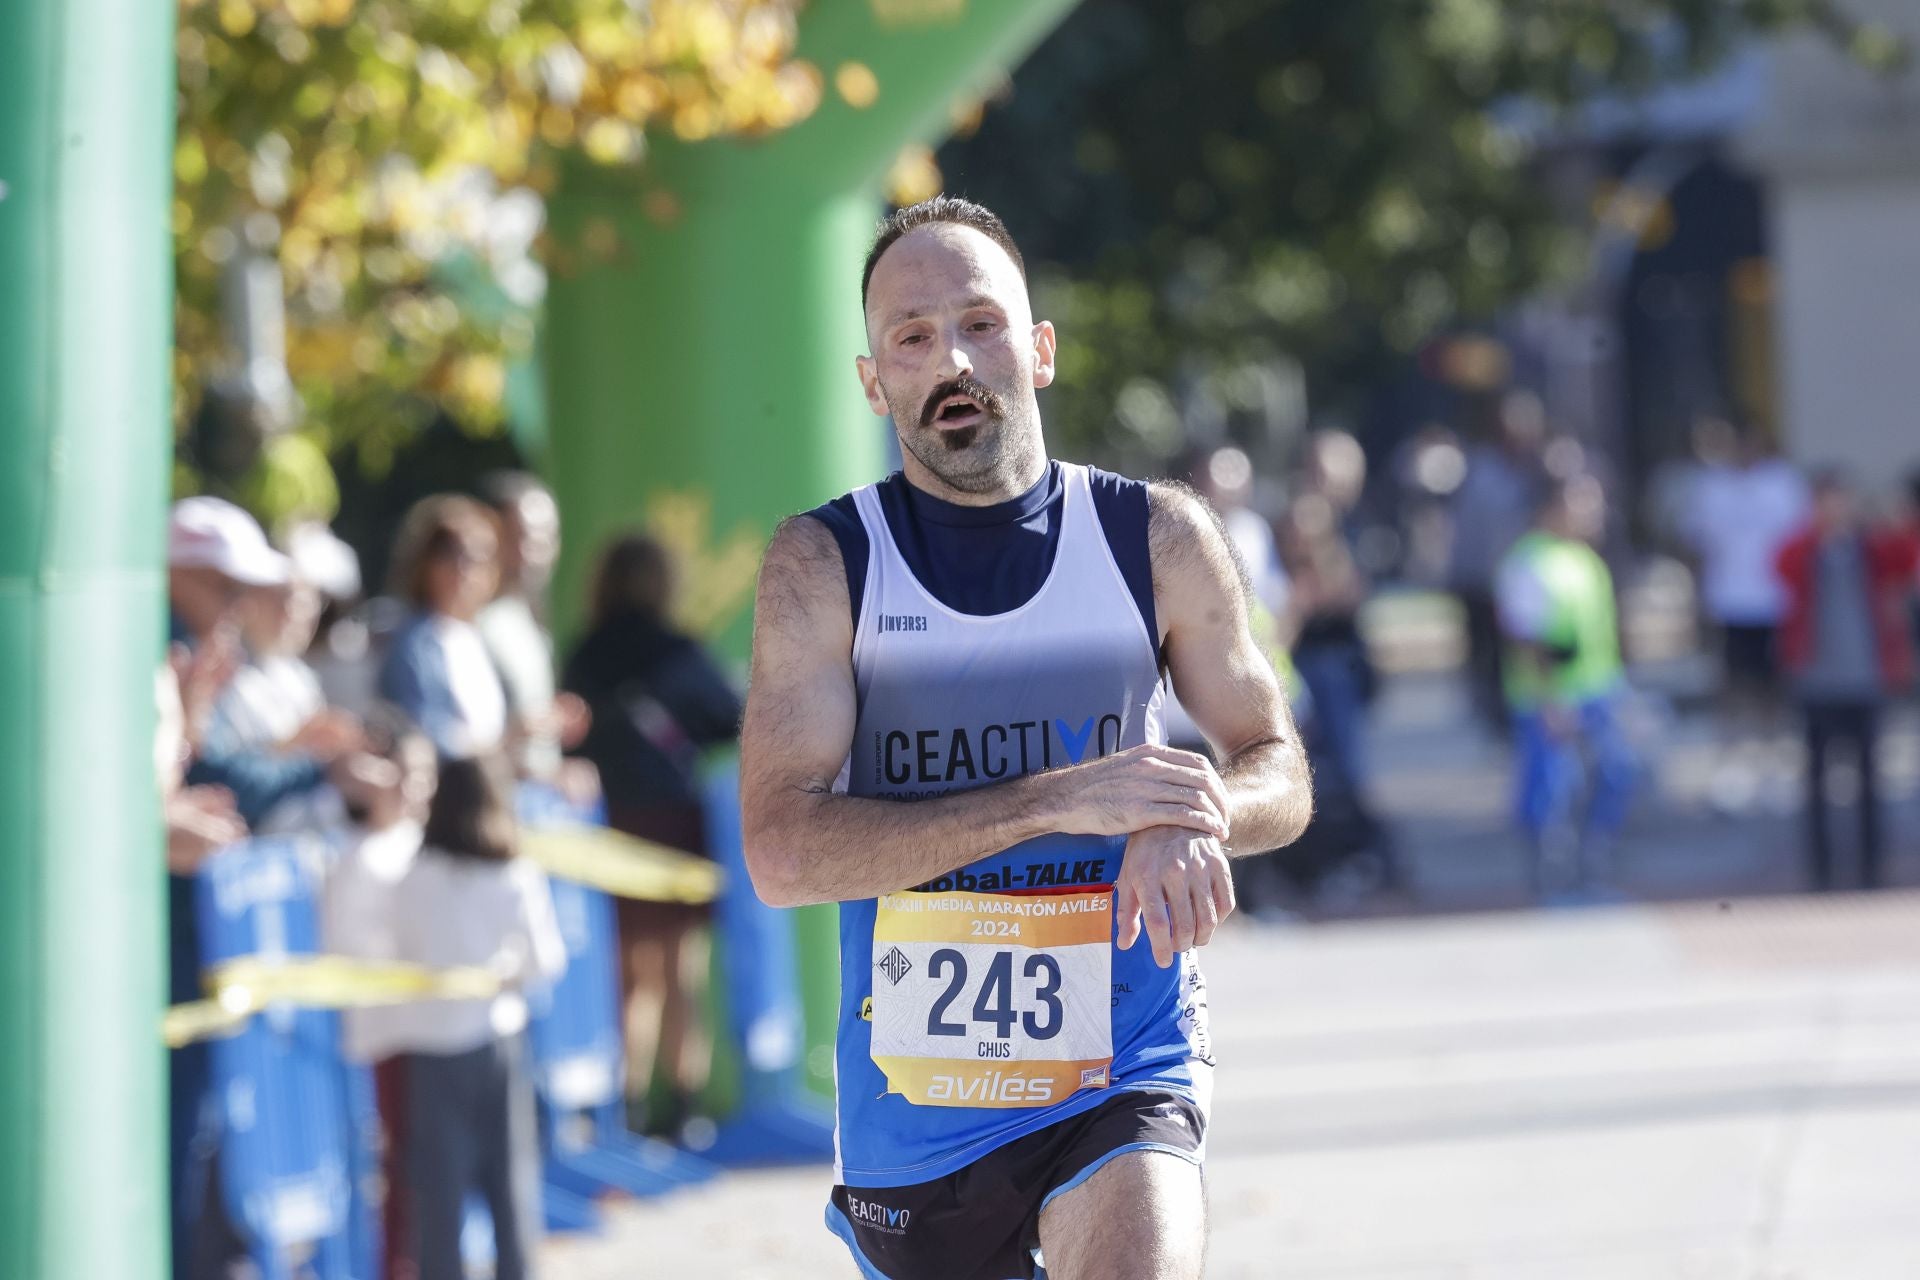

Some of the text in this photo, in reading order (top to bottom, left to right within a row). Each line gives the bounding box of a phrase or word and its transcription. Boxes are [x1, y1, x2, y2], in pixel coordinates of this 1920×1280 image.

[885, 615, 927, 632] INVERSE
[885, 714, 1121, 785] CEACTIVO
[927, 898, 973, 913] MEDIA
[978, 899, 1056, 917] MARATÓN
[1059, 897, 1108, 915] AVILÉS
[971, 920, 1021, 937] 2024
[927, 949, 1063, 1040] 243
[978, 1041, 1011, 1058] CHUS
[927, 1070, 1054, 1102] avilés
[847, 1193, 910, 1228] CEACTIVO
